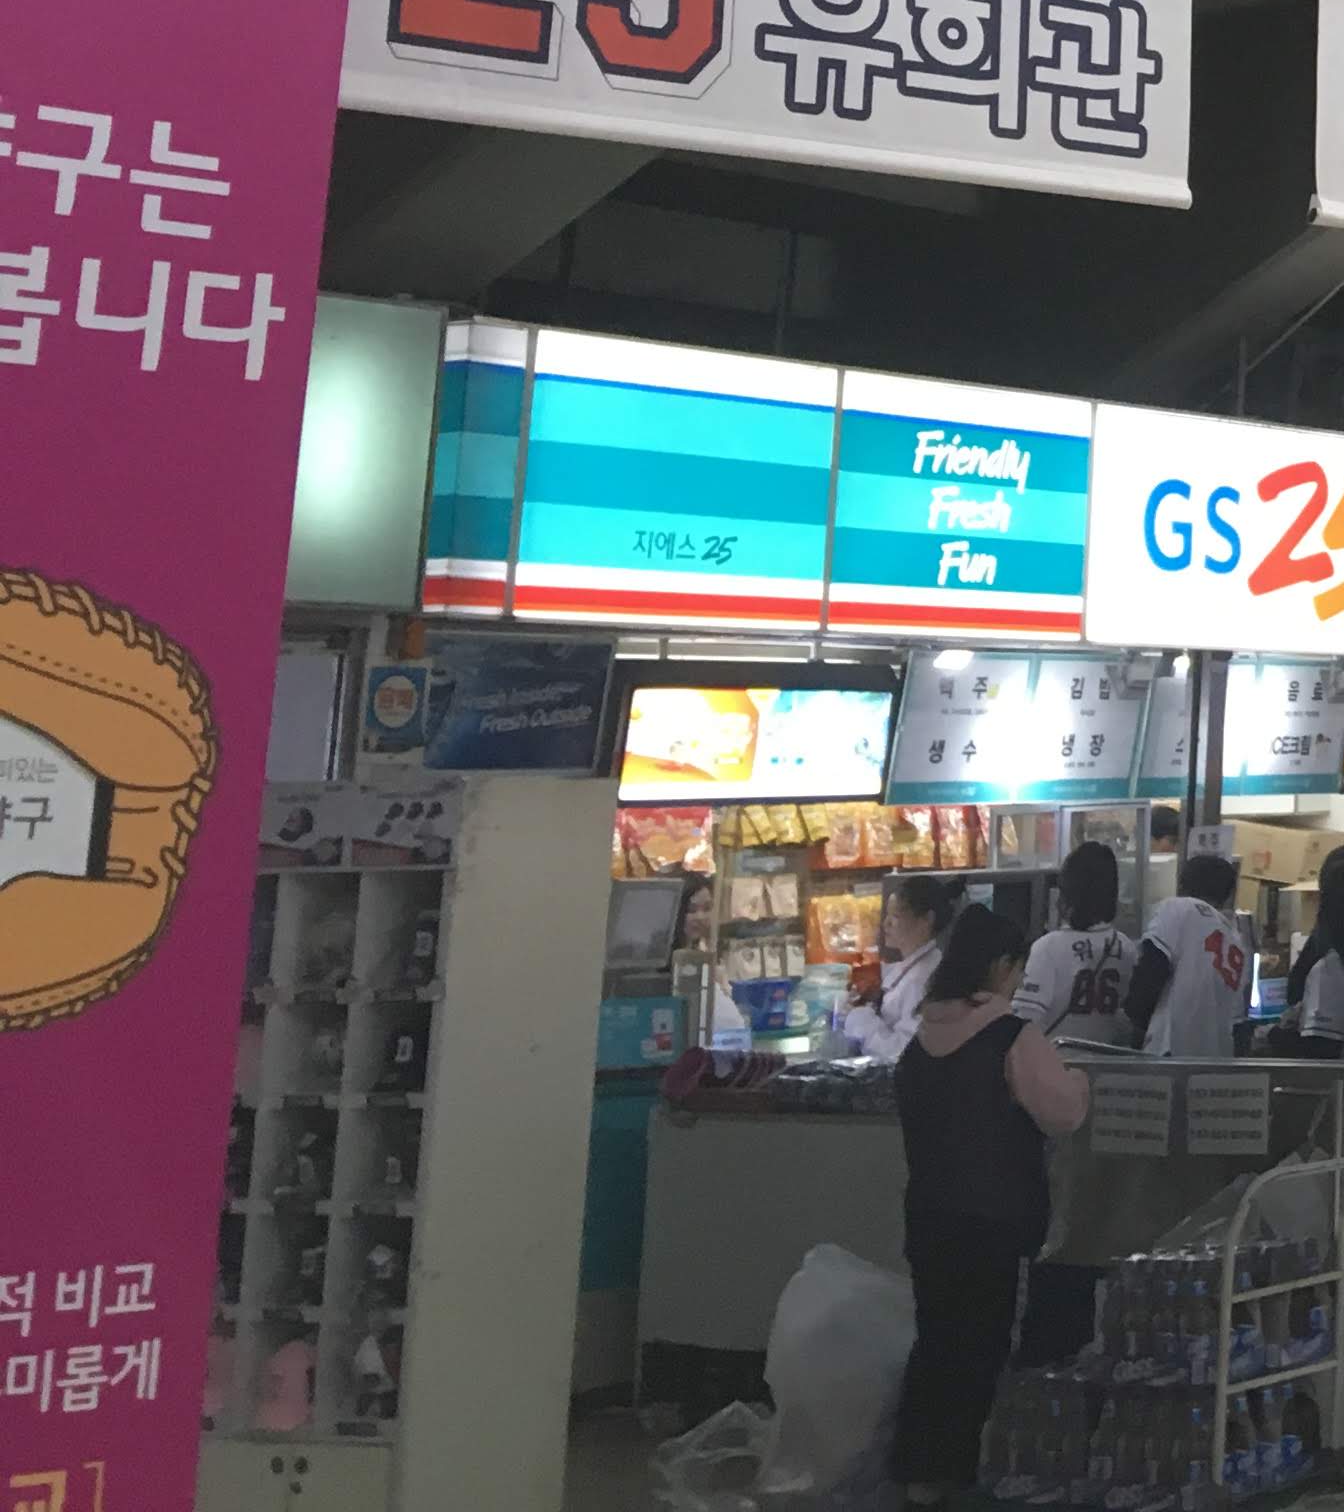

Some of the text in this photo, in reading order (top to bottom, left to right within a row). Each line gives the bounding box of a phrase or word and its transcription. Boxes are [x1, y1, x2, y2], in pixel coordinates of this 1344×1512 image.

[912, 429, 1032, 495] Friendly
[927, 484, 1013, 534] Fresh
[937, 539, 998, 586] Fun
[55, 1263, 156, 1329] 비교
